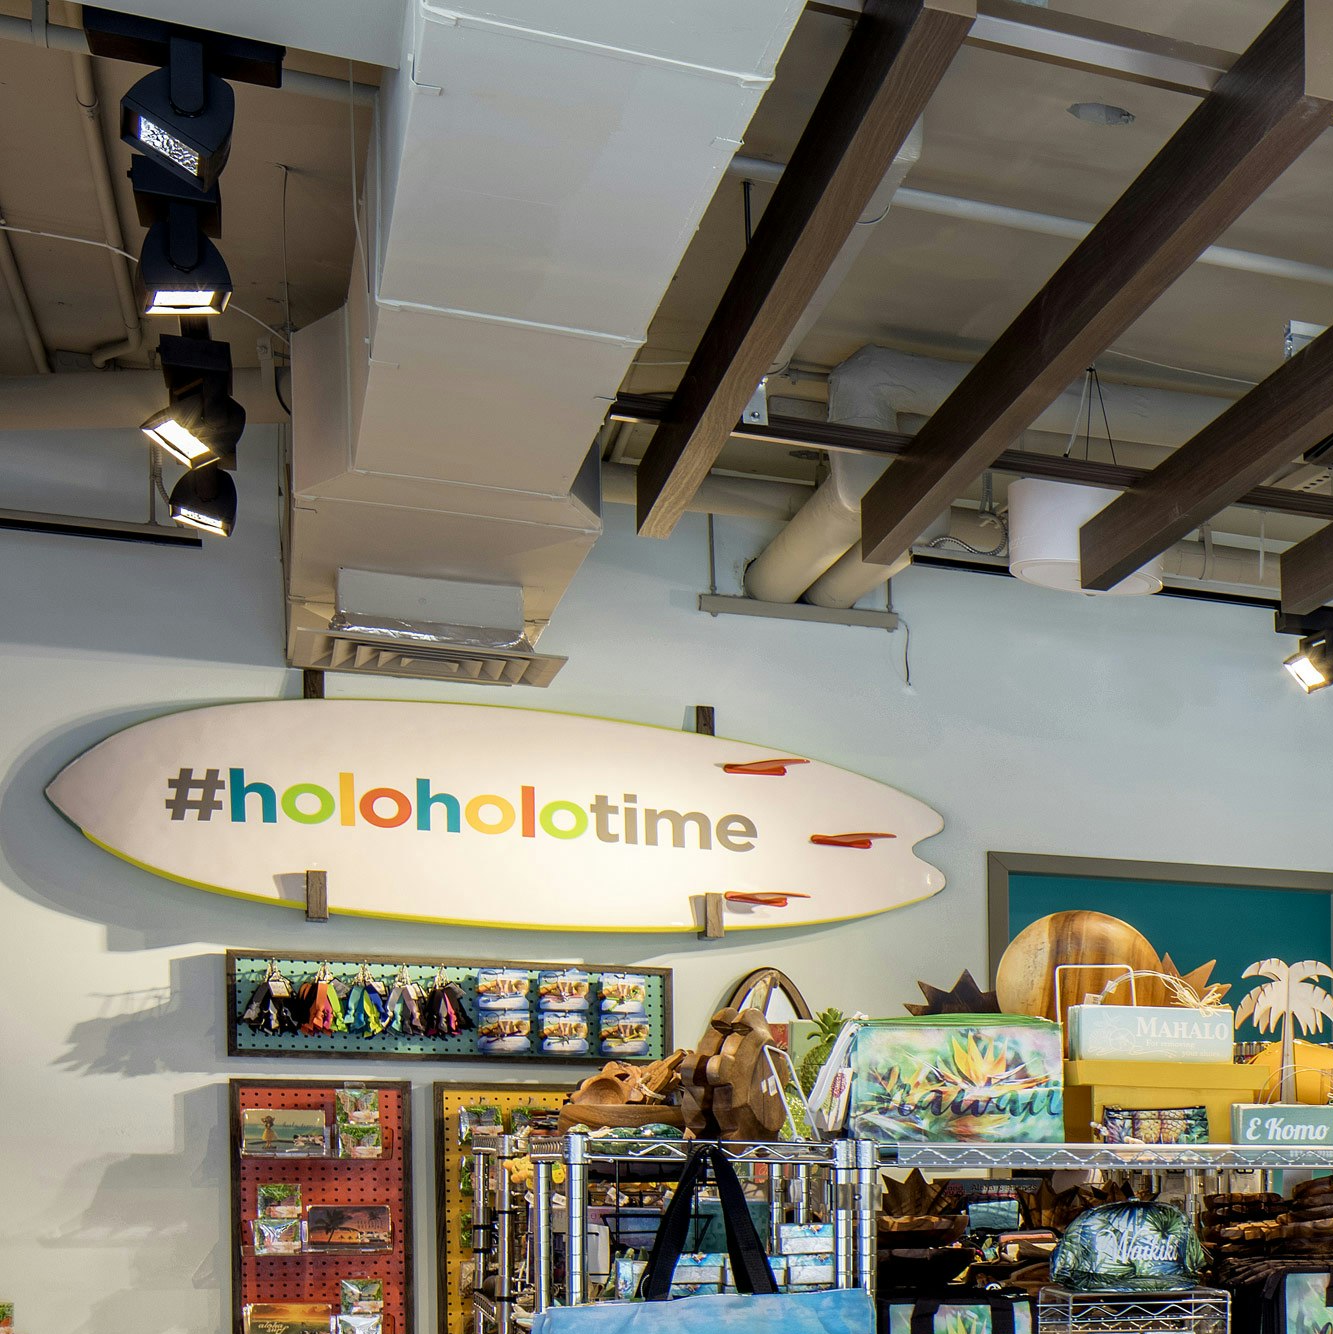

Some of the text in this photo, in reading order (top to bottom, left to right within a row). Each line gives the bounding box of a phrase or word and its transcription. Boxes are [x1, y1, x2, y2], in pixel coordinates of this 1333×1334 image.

[165, 765, 759, 853] #holoholotime
[1136, 1016, 1230, 1040] MAHALO
[1246, 1119, 1264, 1139] E
[1269, 1117, 1328, 1140] Komo
